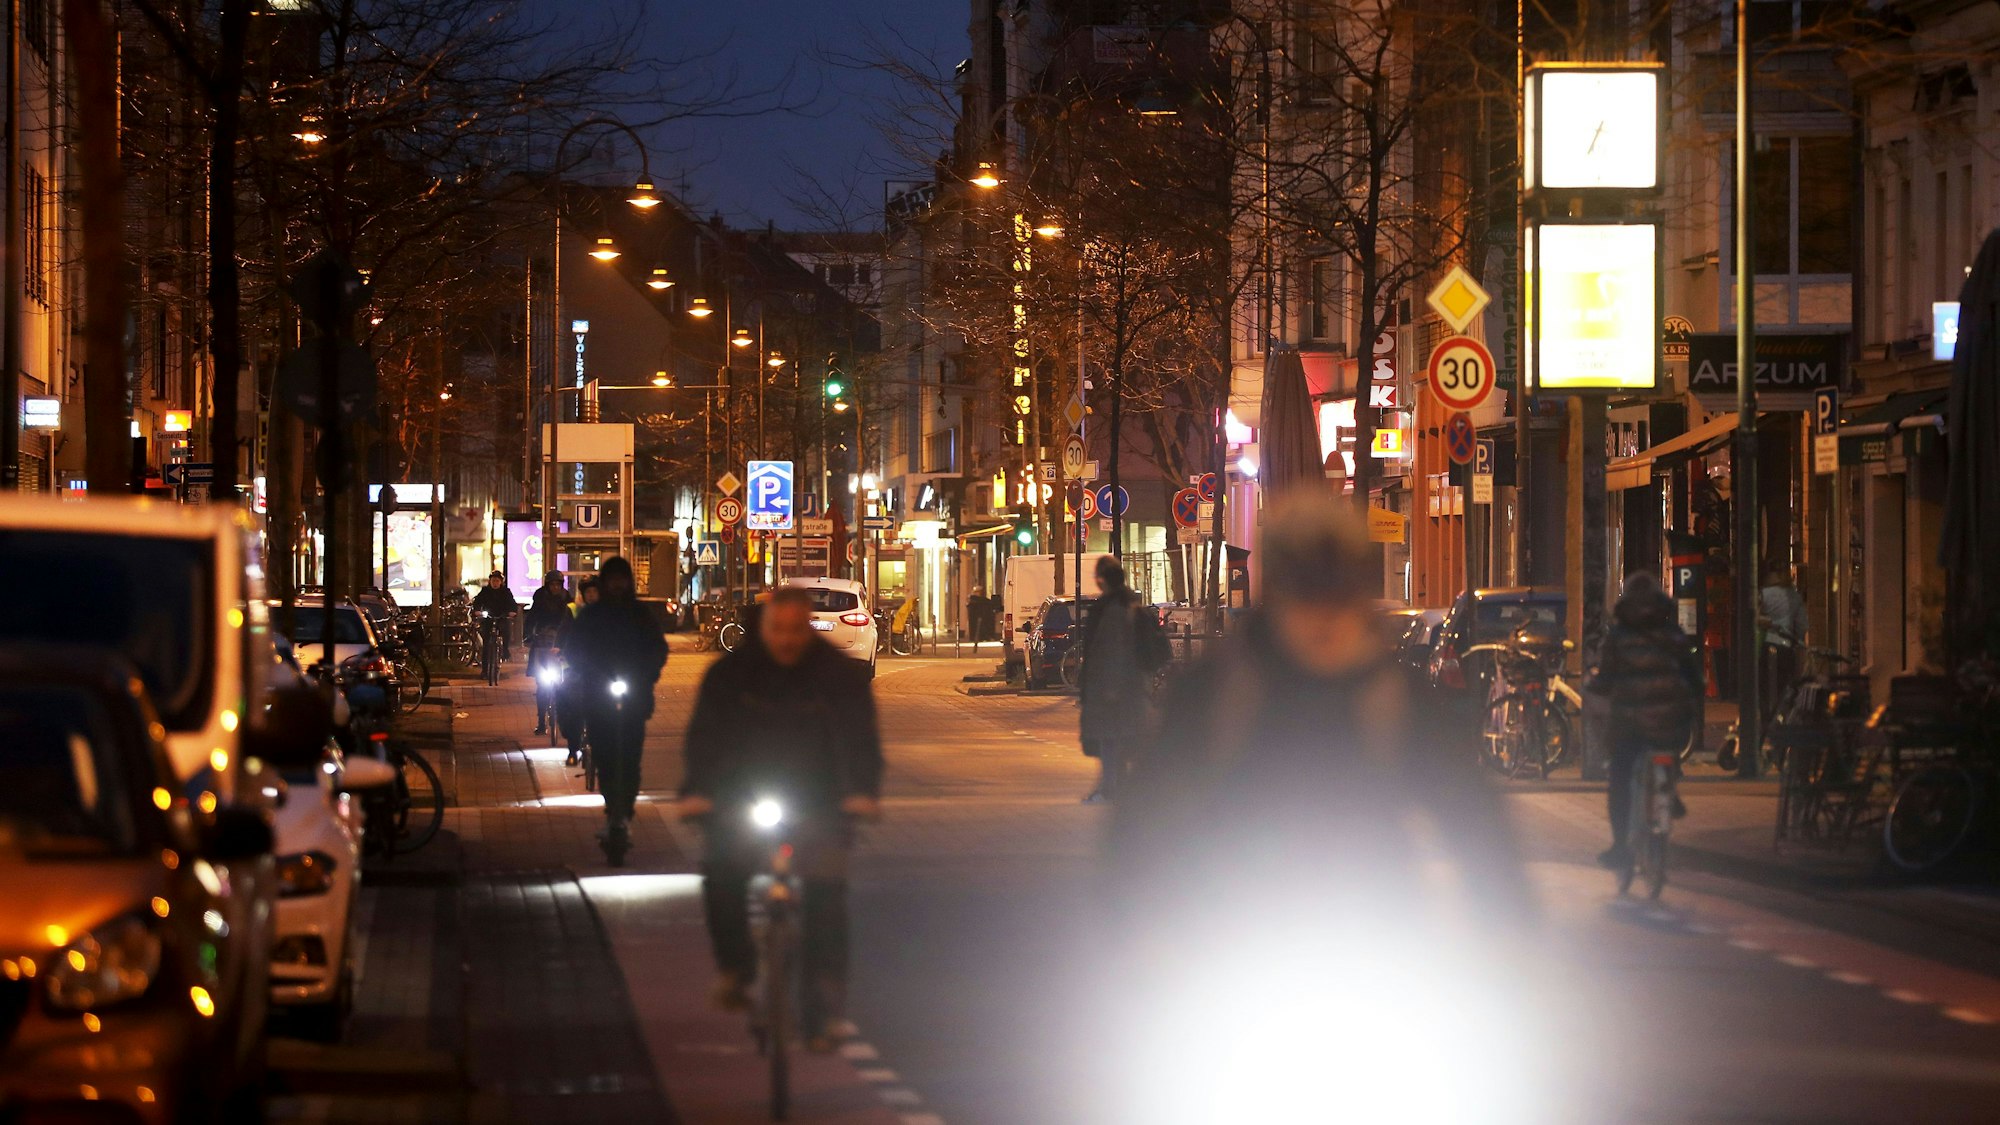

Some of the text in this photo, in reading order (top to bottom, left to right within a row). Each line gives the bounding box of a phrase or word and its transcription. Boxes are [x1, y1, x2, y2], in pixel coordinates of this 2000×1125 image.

[1442, 357, 1480, 389] 30
[1818, 395, 1831, 434] P
[1067, 446, 1082, 466] 30
[1476, 444, 1488, 473] P
[758, 476, 782, 509] P
[578, 506, 598, 527] U
[721, 505, 737, 518] 30
[1232, 568, 1243, 581] P
[1680, 568, 1692, 586] P
